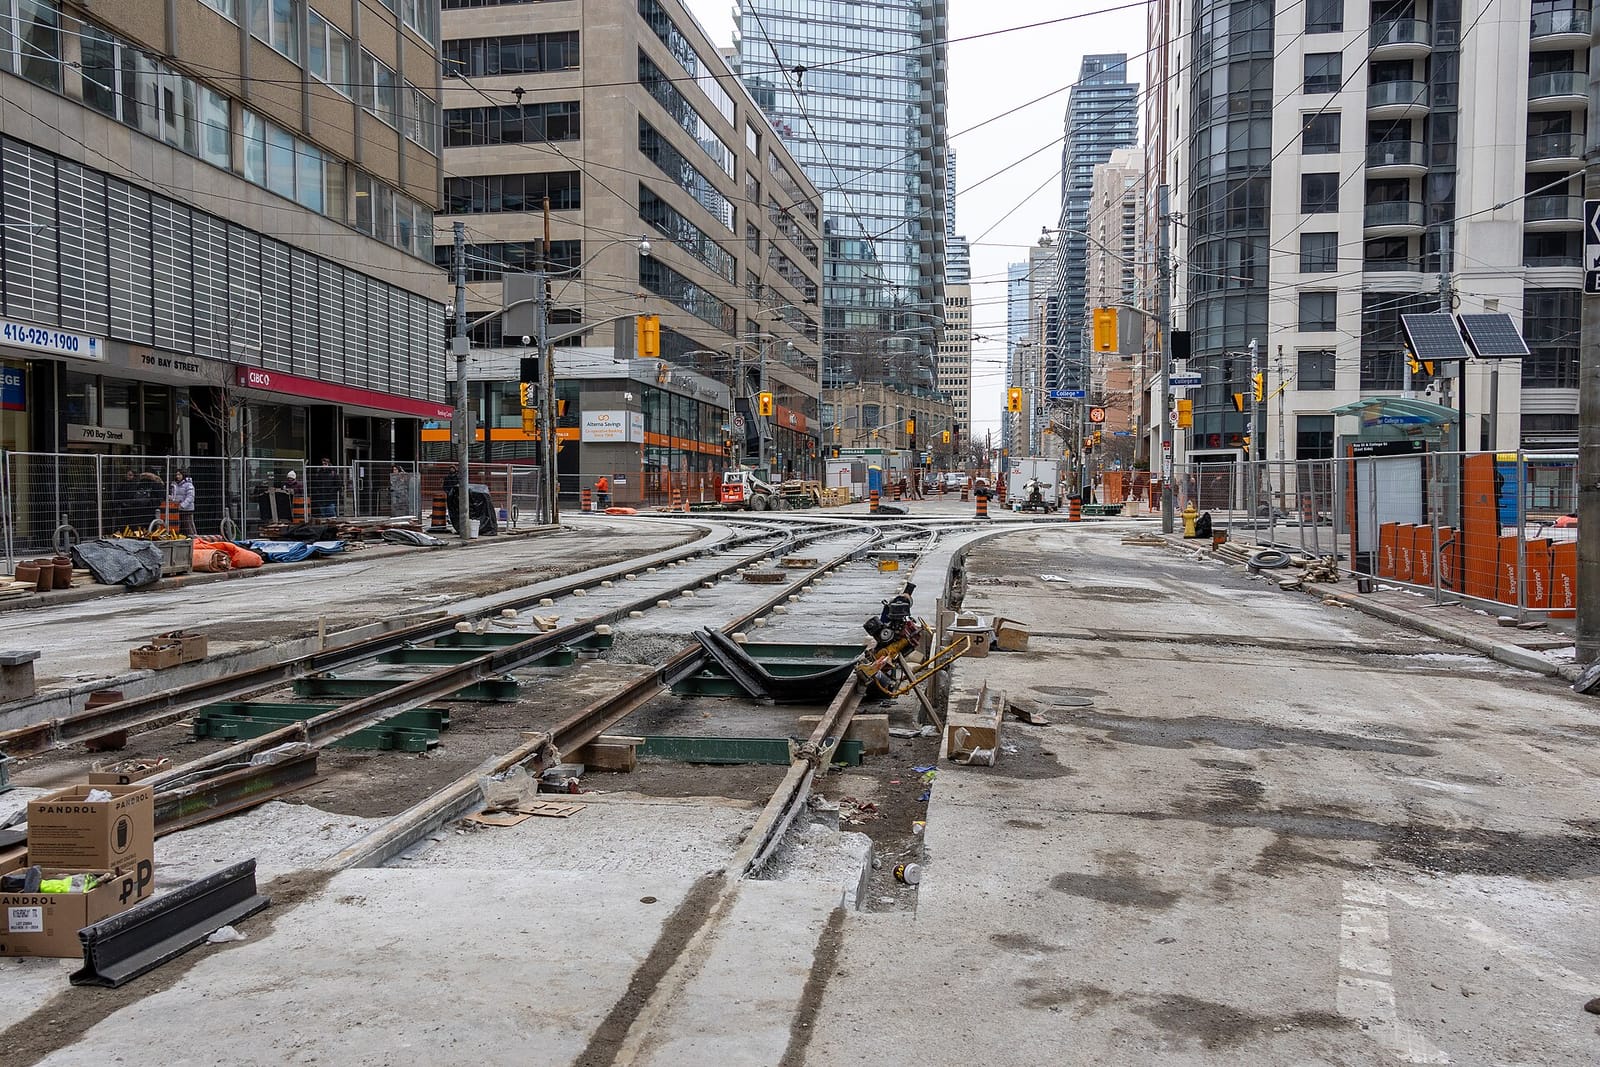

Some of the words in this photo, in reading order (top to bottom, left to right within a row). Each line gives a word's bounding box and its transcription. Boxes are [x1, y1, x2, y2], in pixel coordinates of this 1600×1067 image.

[141, 355, 155, 365] 790
[158, 358, 172, 368] BAY
[174, 360, 199, 373] STREET
[249, 372, 264, 384] CIBC
[82, 429, 95, 438] 790
[96, 430, 106, 440] Bay
[107, 430, 123, 440] Street
[1508, 565, 1517, 595] Tangerine
[1535, 570, 1544, 601] Tangerine
[1563, 575, 1573, 608] Tangerine
[38, 806, 97, 814] PANDROL
[115, 793, 149, 810] PANDROL
